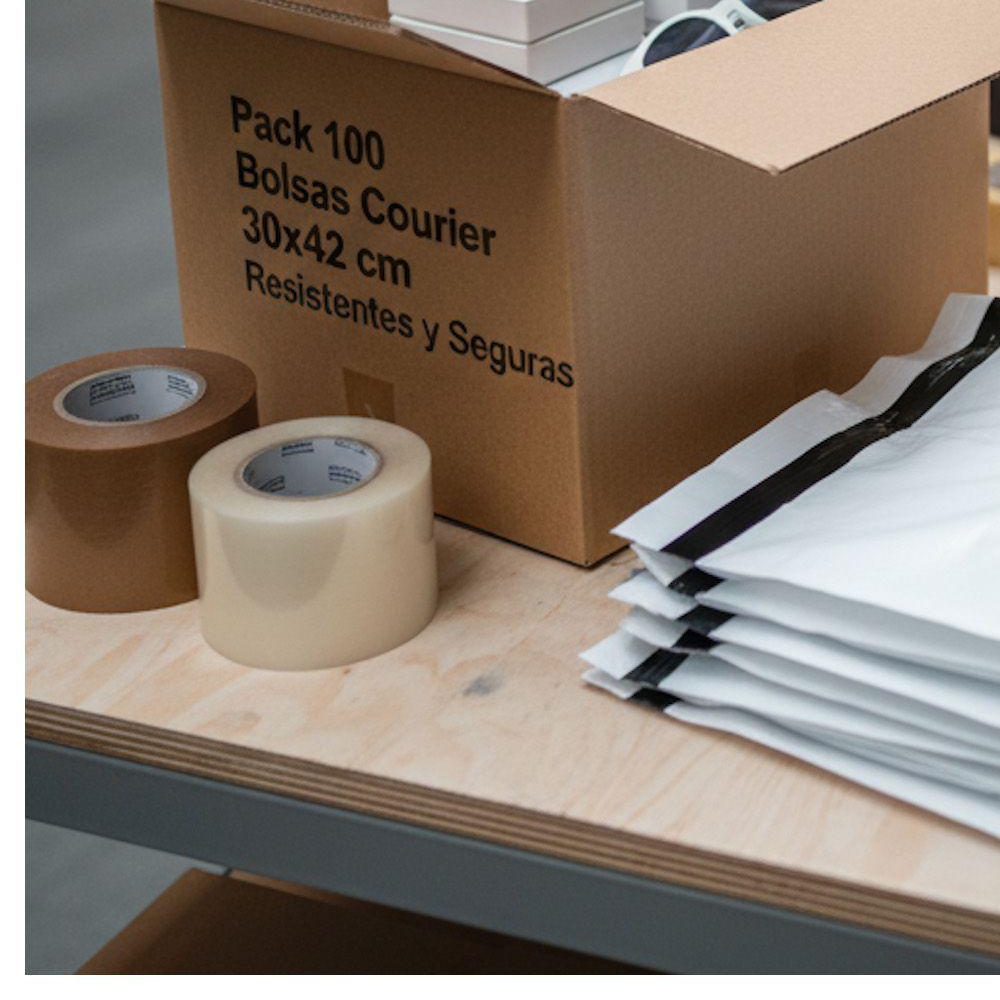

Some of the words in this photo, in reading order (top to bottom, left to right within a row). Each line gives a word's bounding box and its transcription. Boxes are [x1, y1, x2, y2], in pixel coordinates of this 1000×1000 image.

[231, 95, 313, 152] Pack
[325, 121, 385, 170] 100
[236, 151, 350, 216] Bolsas
[361, 187, 496, 256] Courier
[242, 206, 346, 270] 30x42
[357, 248, 411, 288] cm
[245, 260, 413, 338] Resistentes
[422, 318, 439, 352] y
[449, 320, 574, 388] Seguras
